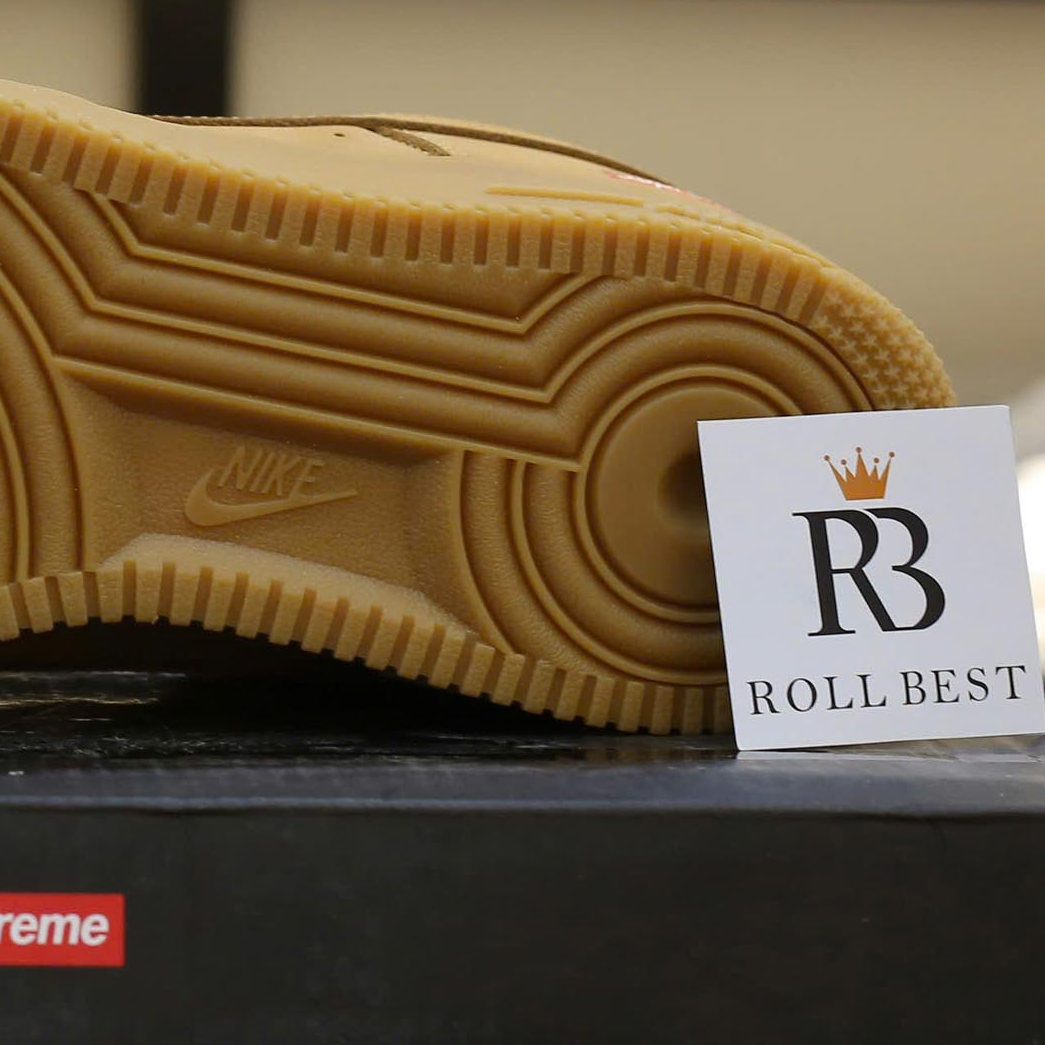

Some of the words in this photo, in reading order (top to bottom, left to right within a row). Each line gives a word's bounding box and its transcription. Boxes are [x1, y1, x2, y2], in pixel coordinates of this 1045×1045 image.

[217, 445, 325, 501] NIKE
[746, 673, 888, 716] ROLL
[899, 665, 1026, 706] BEST
